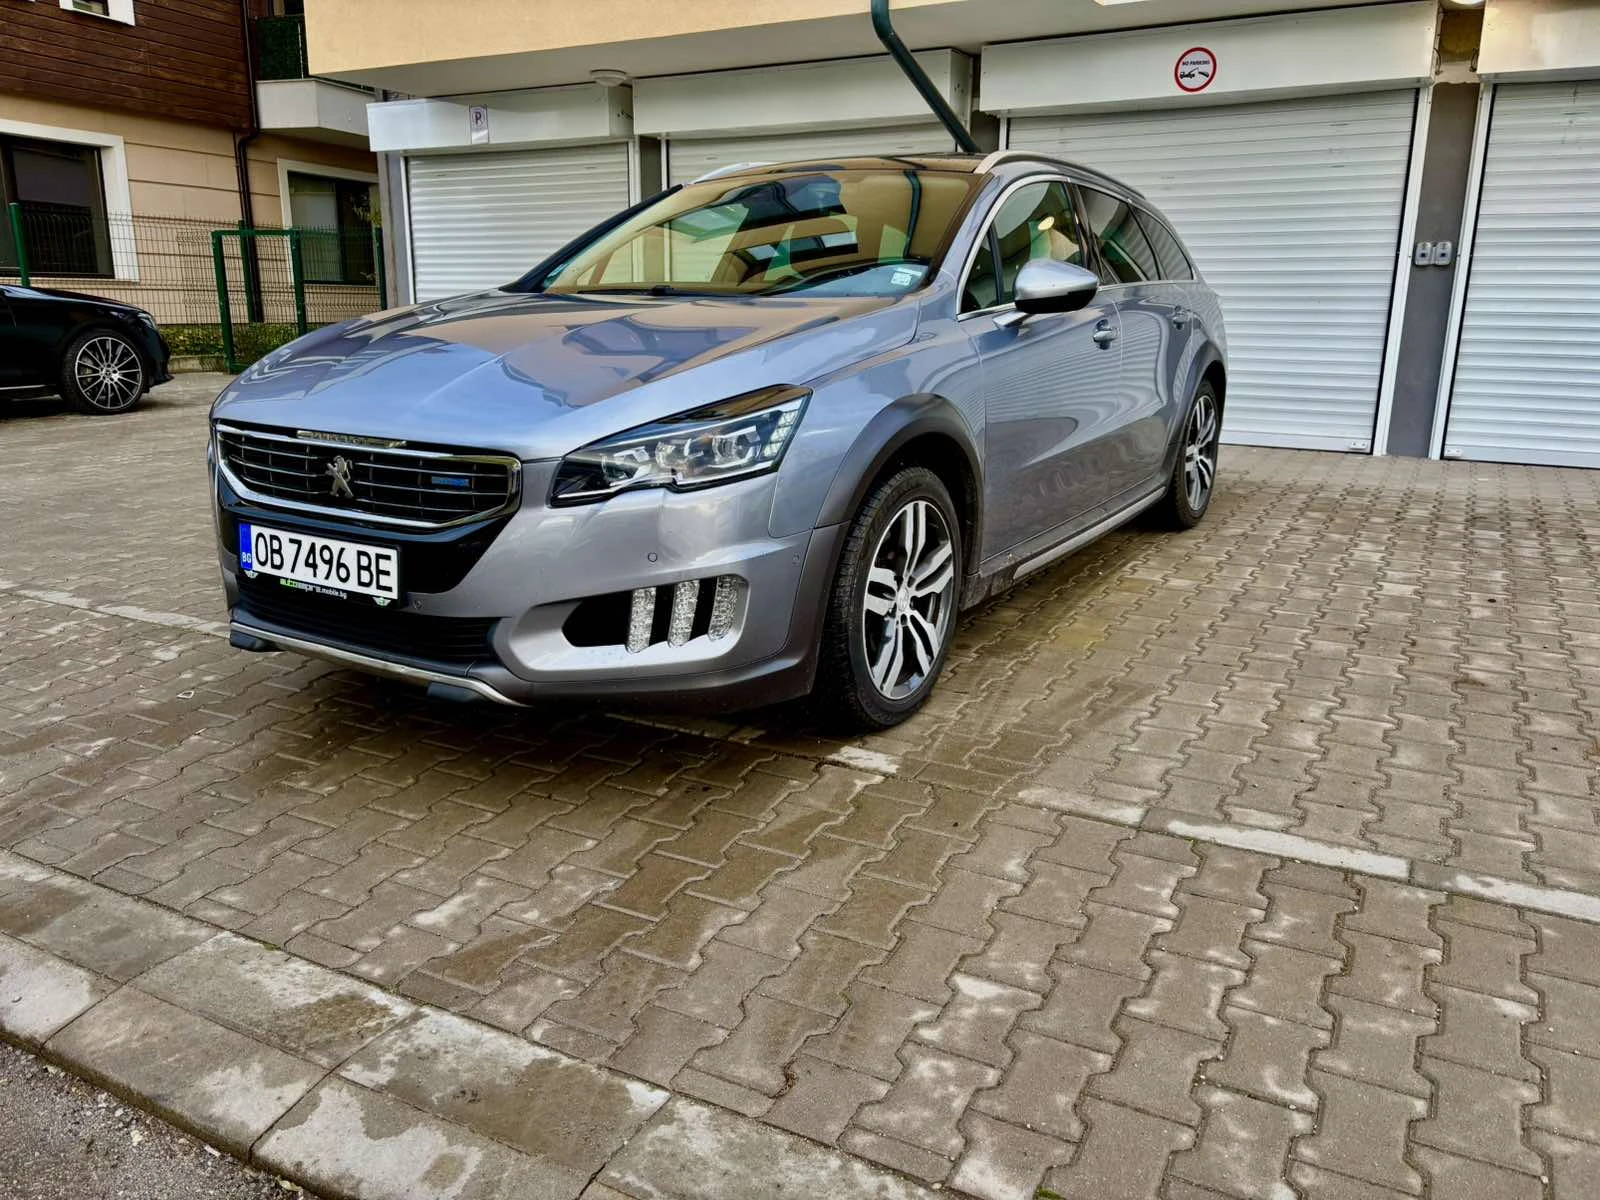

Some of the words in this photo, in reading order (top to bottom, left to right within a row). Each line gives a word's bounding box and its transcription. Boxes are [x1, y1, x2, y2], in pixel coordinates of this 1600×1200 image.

[241, 551, 252, 564] BG
[288, 538, 351, 584] 7496
[356, 549, 393, 593] BE
